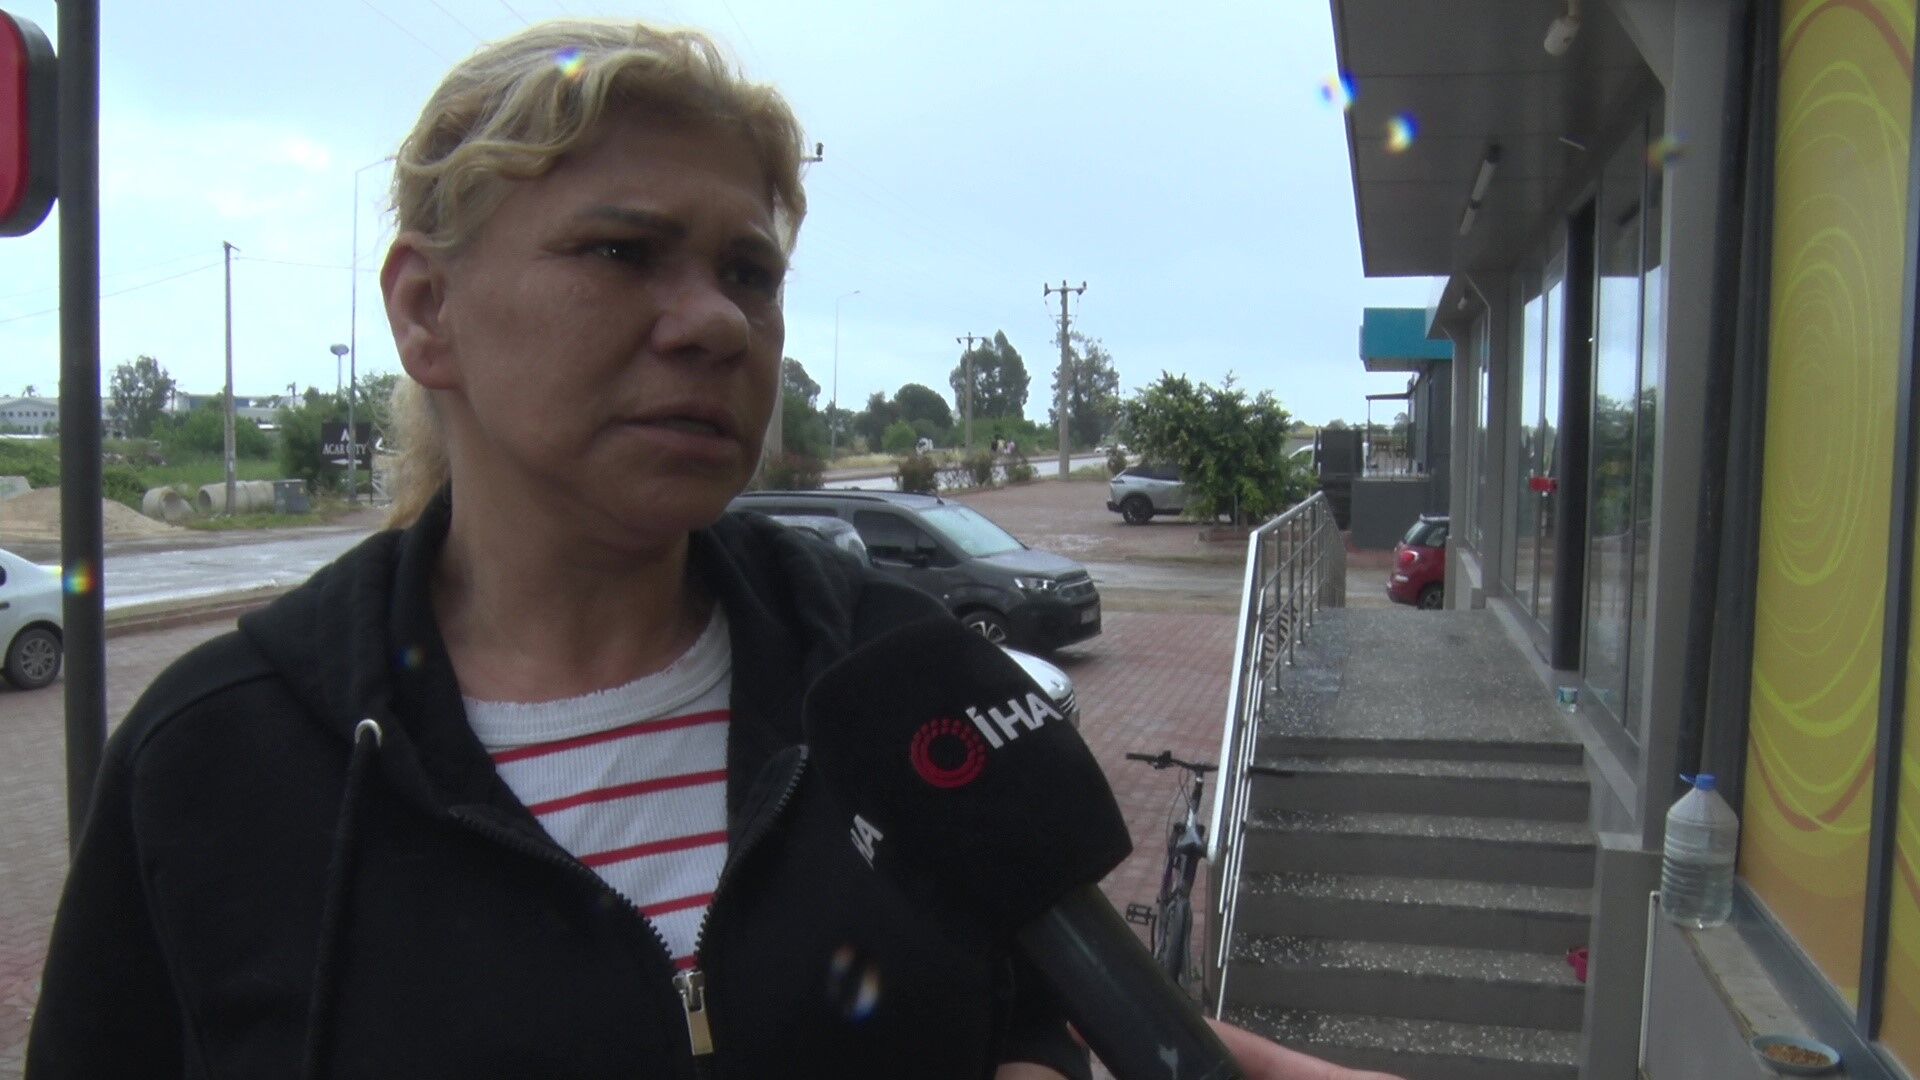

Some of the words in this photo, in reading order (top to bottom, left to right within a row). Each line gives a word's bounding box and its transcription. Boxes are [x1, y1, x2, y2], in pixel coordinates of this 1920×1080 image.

[322, 443, 345, 455] ACAR
[346, 443, 367, 455] CTY
[965, 692, 1063, 749] İHA
[850, 814, 884, 871] HA
